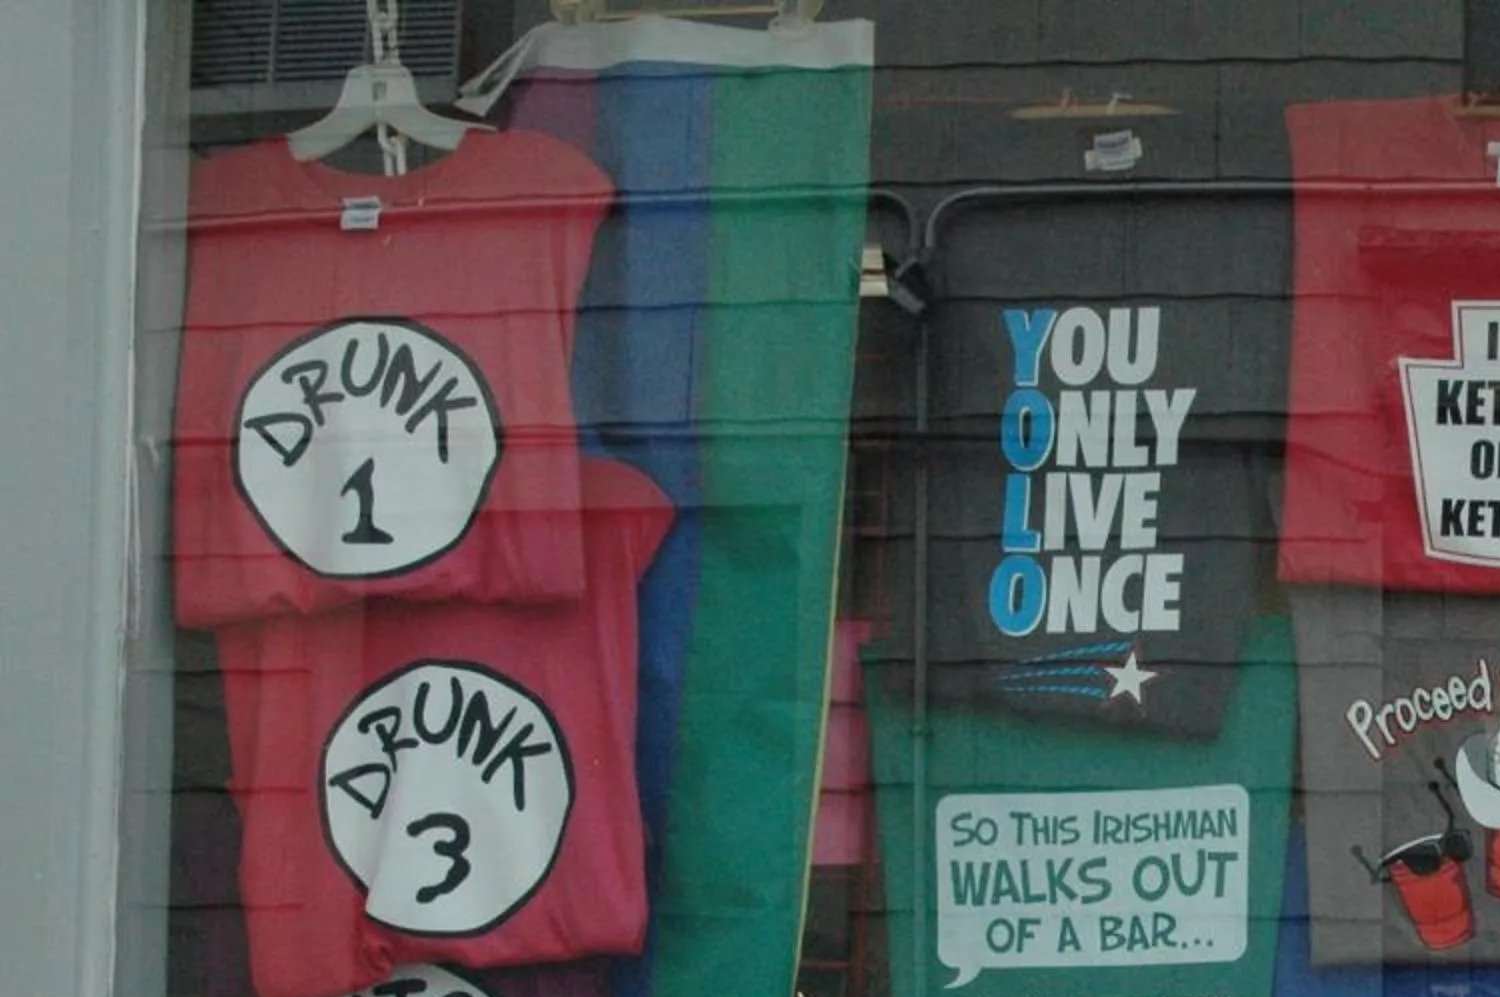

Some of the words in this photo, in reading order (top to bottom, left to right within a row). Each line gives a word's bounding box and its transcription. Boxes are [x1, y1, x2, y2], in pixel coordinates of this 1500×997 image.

[1003, 307, 1161, 387] YOU
[1487, 321, 1499, 360] I
[245, 333, 477, 465] DRUNK
[1001, 388, 1197, 472] ONLY
[340, 458, 394, 545] 1
[1002, 472, 1161, 553] LIVE
[989, 554, 1184, 637] ONCE
[329, 676, 552, 819] DRUNK
[1346, 659, 1492, 760] Proceed
[406, 812, 471, 904] 3
[951, 812, 998, 847] SO
[1009, 811, 1081, 845] THIS
[1093, 808, 1238, 845] IRISHMAN
[951, 857, 1113, 906] WALKS
[1132, 849, 1239, 902] OUT
[986, 917, 1041, 953] OF
[1057, 917, 1081, 952] A
[1099, 912, 1214, 951] BAR...
